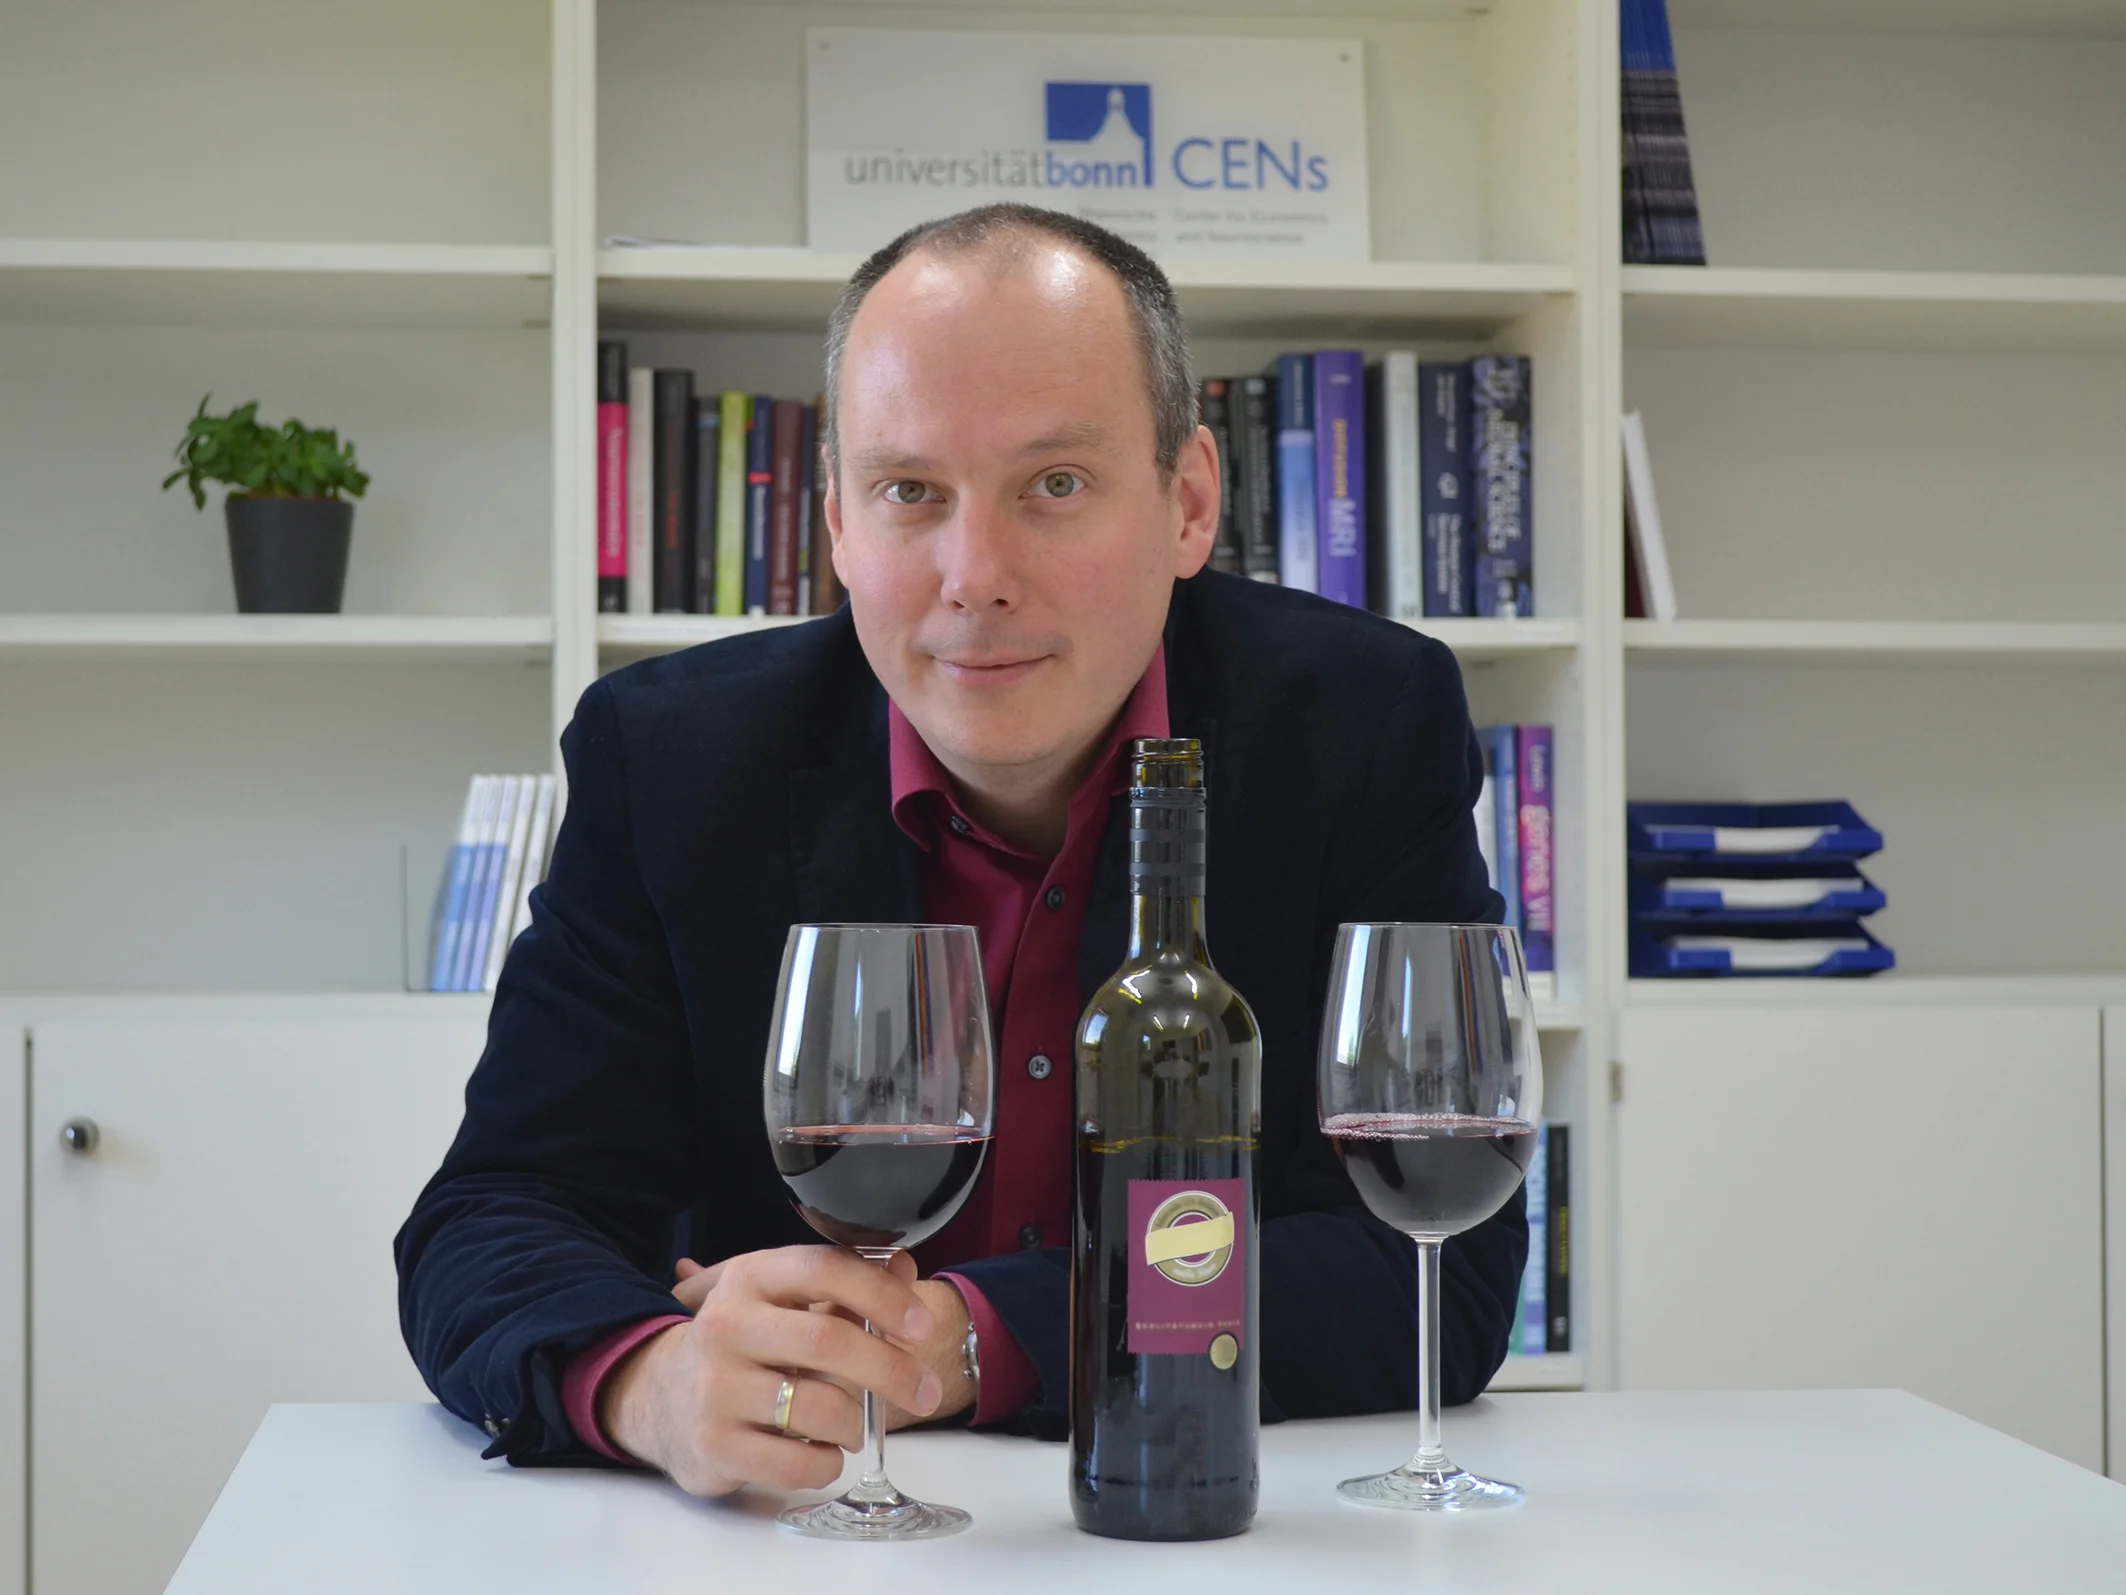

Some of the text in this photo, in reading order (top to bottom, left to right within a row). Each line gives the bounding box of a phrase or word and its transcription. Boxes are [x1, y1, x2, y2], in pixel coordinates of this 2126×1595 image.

[1171, 137, 1330, 191] CENs
[1329, 498, 1357, 556] MRI
[1521, 804, 1550, 892] genes
